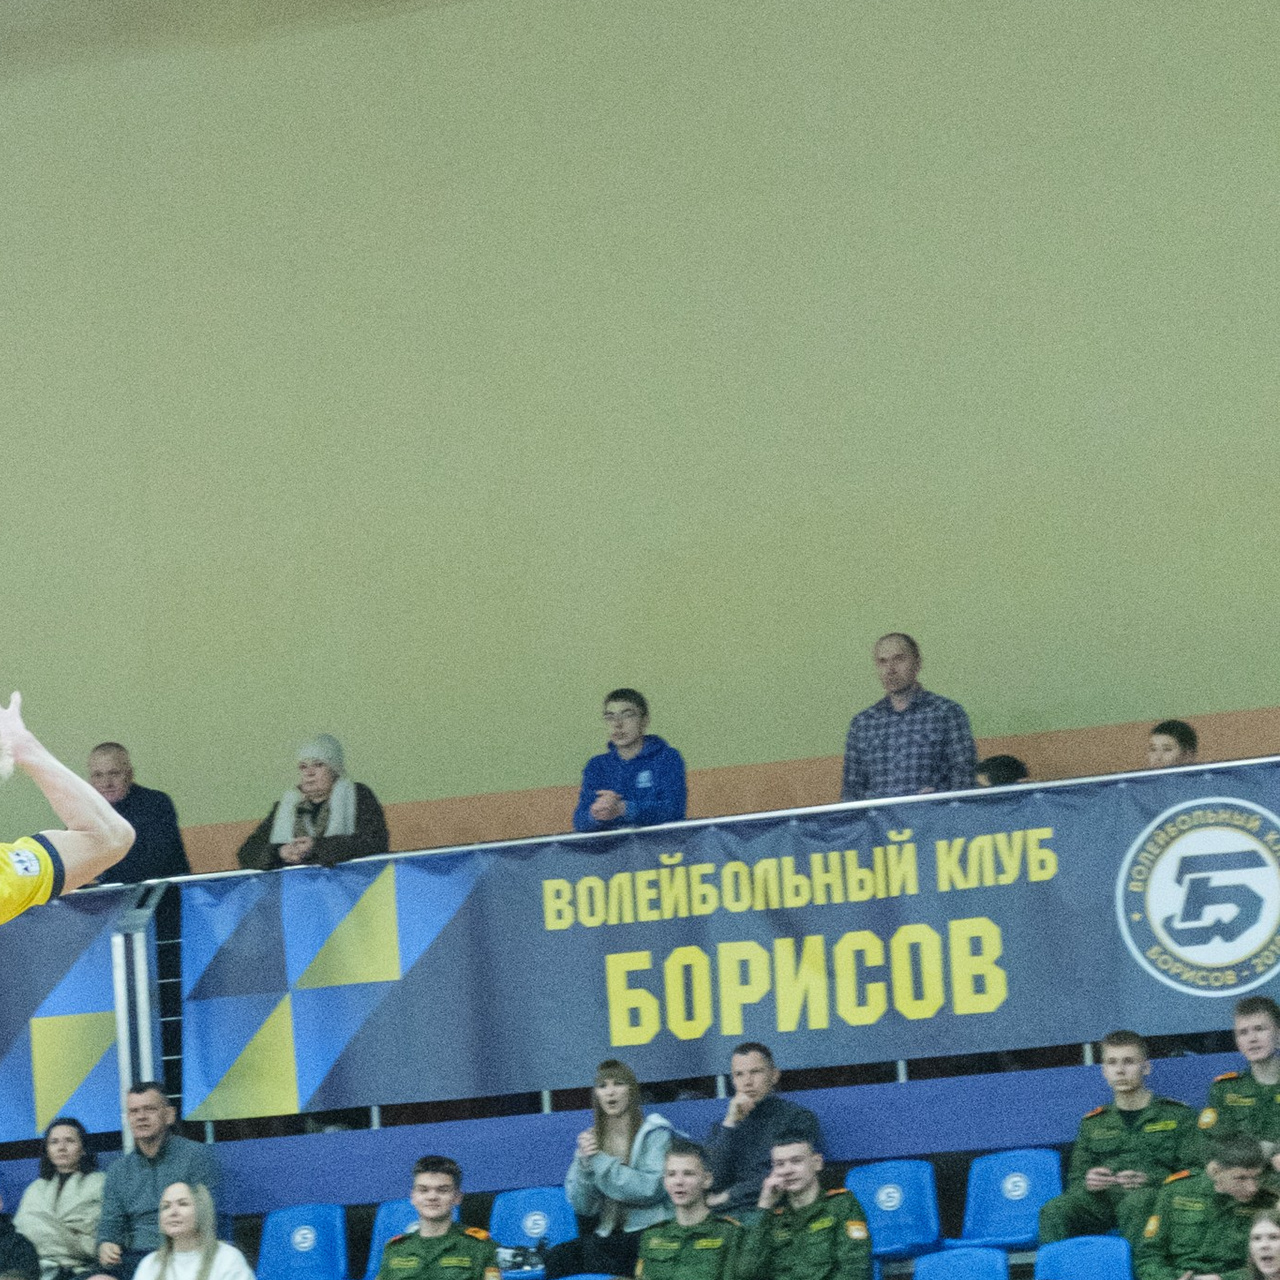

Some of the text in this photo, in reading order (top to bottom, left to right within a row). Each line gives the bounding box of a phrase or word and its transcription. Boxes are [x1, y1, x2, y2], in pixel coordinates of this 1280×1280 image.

[542, 827, 1058, 931] ВОЛЕЙБОЛЬНЫЙ КЛУБ
[604, 917, 1008, 1047] БОРИСОВ
